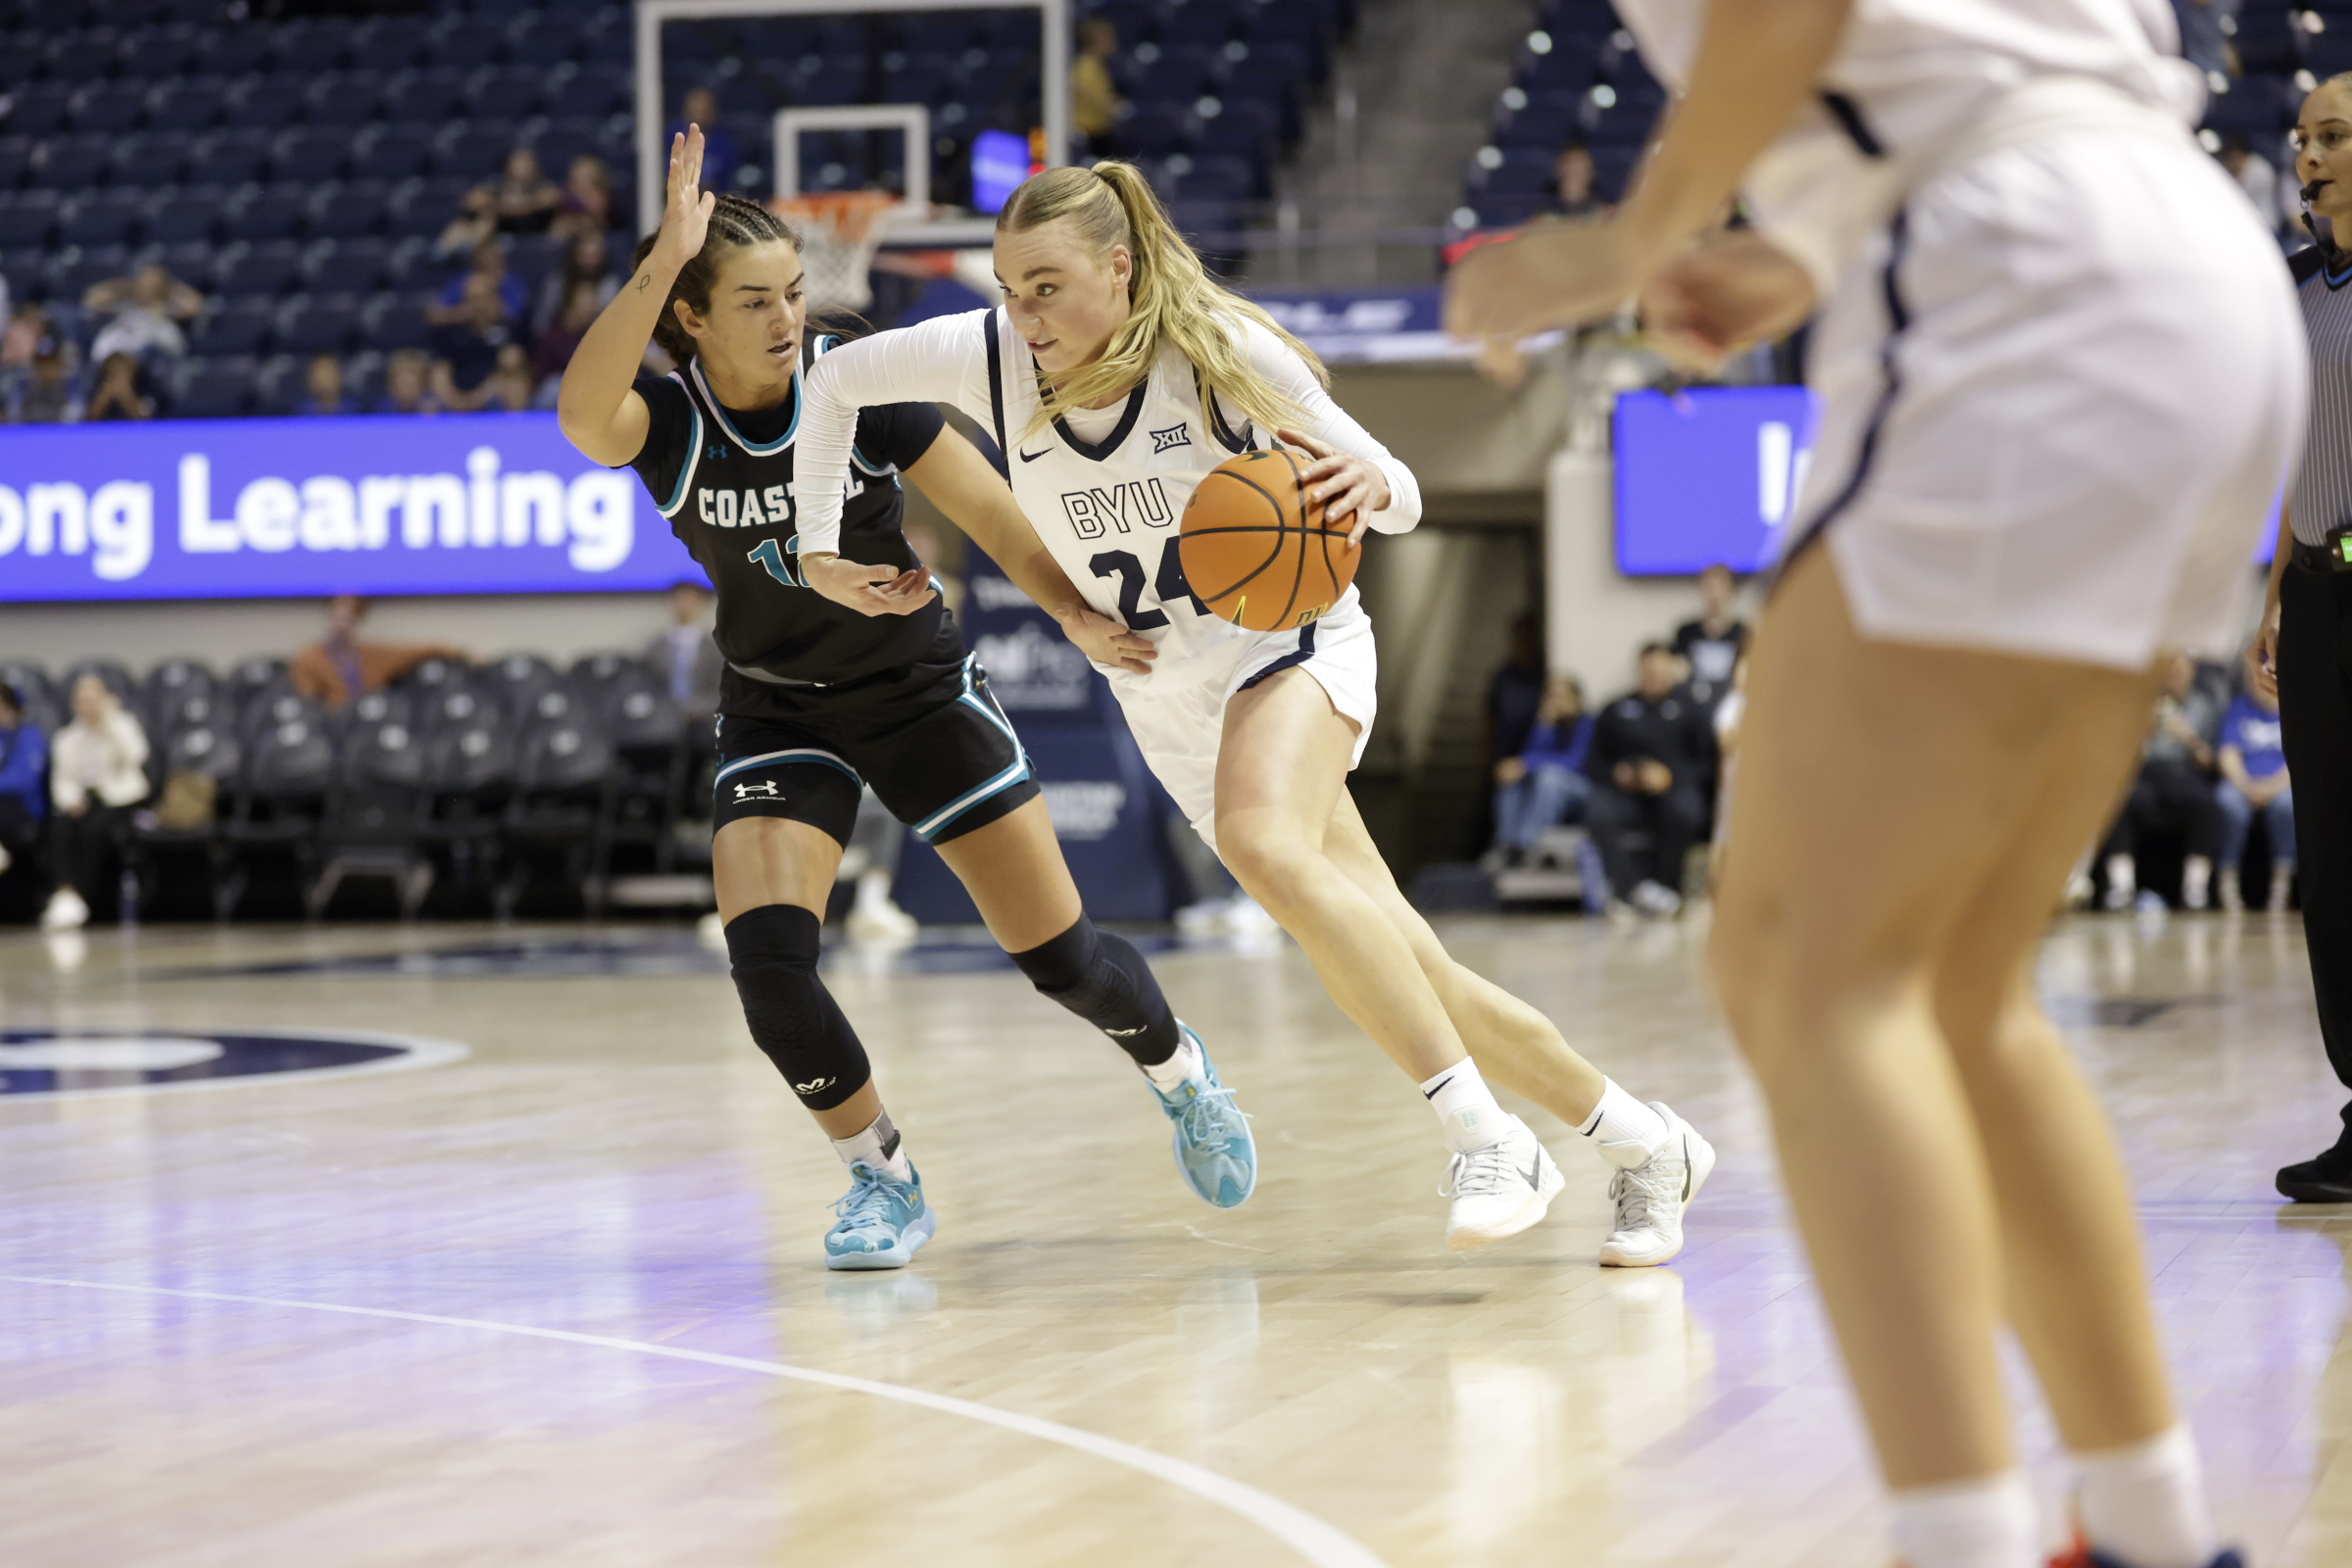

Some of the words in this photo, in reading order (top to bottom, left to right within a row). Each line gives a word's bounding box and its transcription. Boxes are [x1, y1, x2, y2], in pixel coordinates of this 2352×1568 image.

[178, 444, 637, 574] Learning
[698, 468, 864, 528] COASL
[1061, 477, 1174, 540] BYU
[1089, 534, 1213, 631] 24
[733, 796, 756, 805] UNDER
